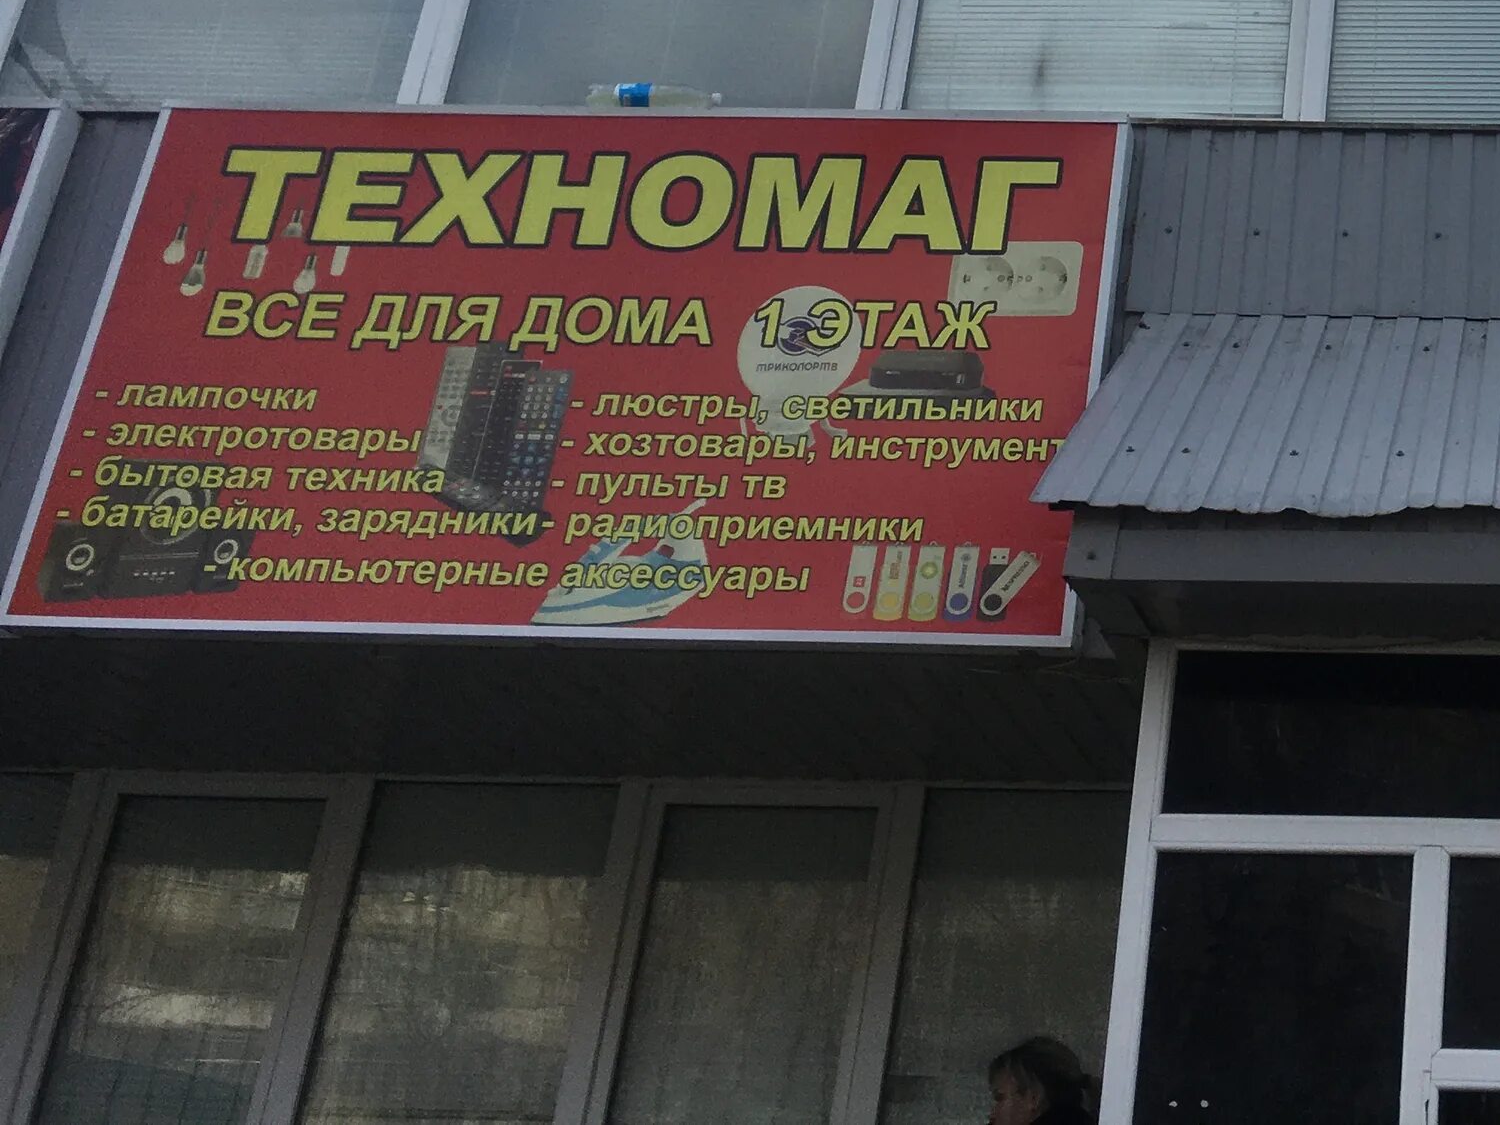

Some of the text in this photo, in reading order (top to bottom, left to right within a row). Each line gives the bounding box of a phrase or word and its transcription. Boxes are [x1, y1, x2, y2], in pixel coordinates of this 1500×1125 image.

[222, 146, 1062, 252] ТЕХНОМАГ
[204, 290, 997, 352] ВСЕ ДЛЯ ДОМА 1 ЭТАЖ
[116, 384, 318, 411] лампочки
[591, 393, 769, 424] люстры,
[782, 395, 1043, 421] светильники
[105, 423, 423, 458] электротовары
[583, 432, 817, 465] хозтовары,
[94, 455, 273, 488] бытовая
[287, 467, 446, 493] техника
[575, 472, 730, 504] пульты
[741, 475, 787, 499] тв
[81, 496, 303, 537] батарейки,
[316, 507, 538, 540] зарядники
[564, 512, 925, 546] радиоприемники
[226, 556, 549, 593] компьютерные
[560, 562, 811, 599] аксессуары
